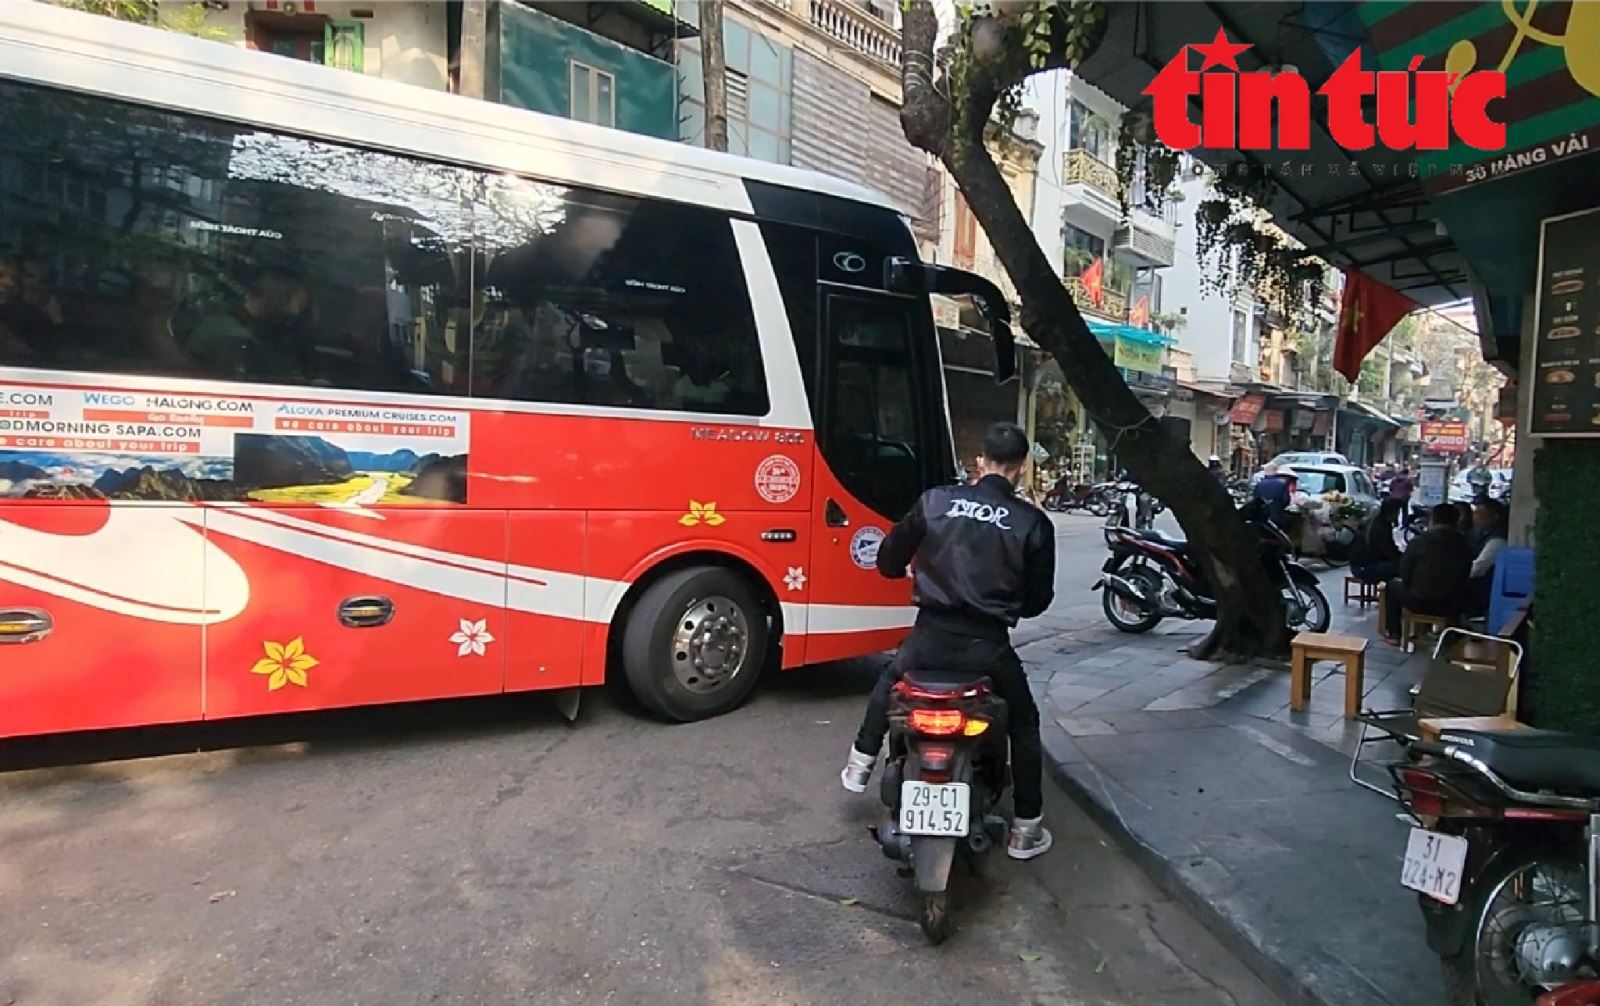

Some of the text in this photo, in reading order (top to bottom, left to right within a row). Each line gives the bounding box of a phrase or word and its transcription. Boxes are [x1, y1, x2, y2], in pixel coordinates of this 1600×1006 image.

[1551, 132, 1589, 156] VẢI
[84, 392, 254, 413] WEGO HALONG.COM
[328, 407, 380, 418] PREMIUM
[116, 424, 201, 438] SAPA.COM
[307, 420, 339, 431] care
[16, 437, 55, 447] care
[63, 438, 112, 450] about
[119, 440, 154, 452] your
[160, 441, 188, 454] trip
[912, 786, 957, 808] 29-C1
[905, 809, 963, 832] 914.52
[1422, 835, 1442, 863] 31
